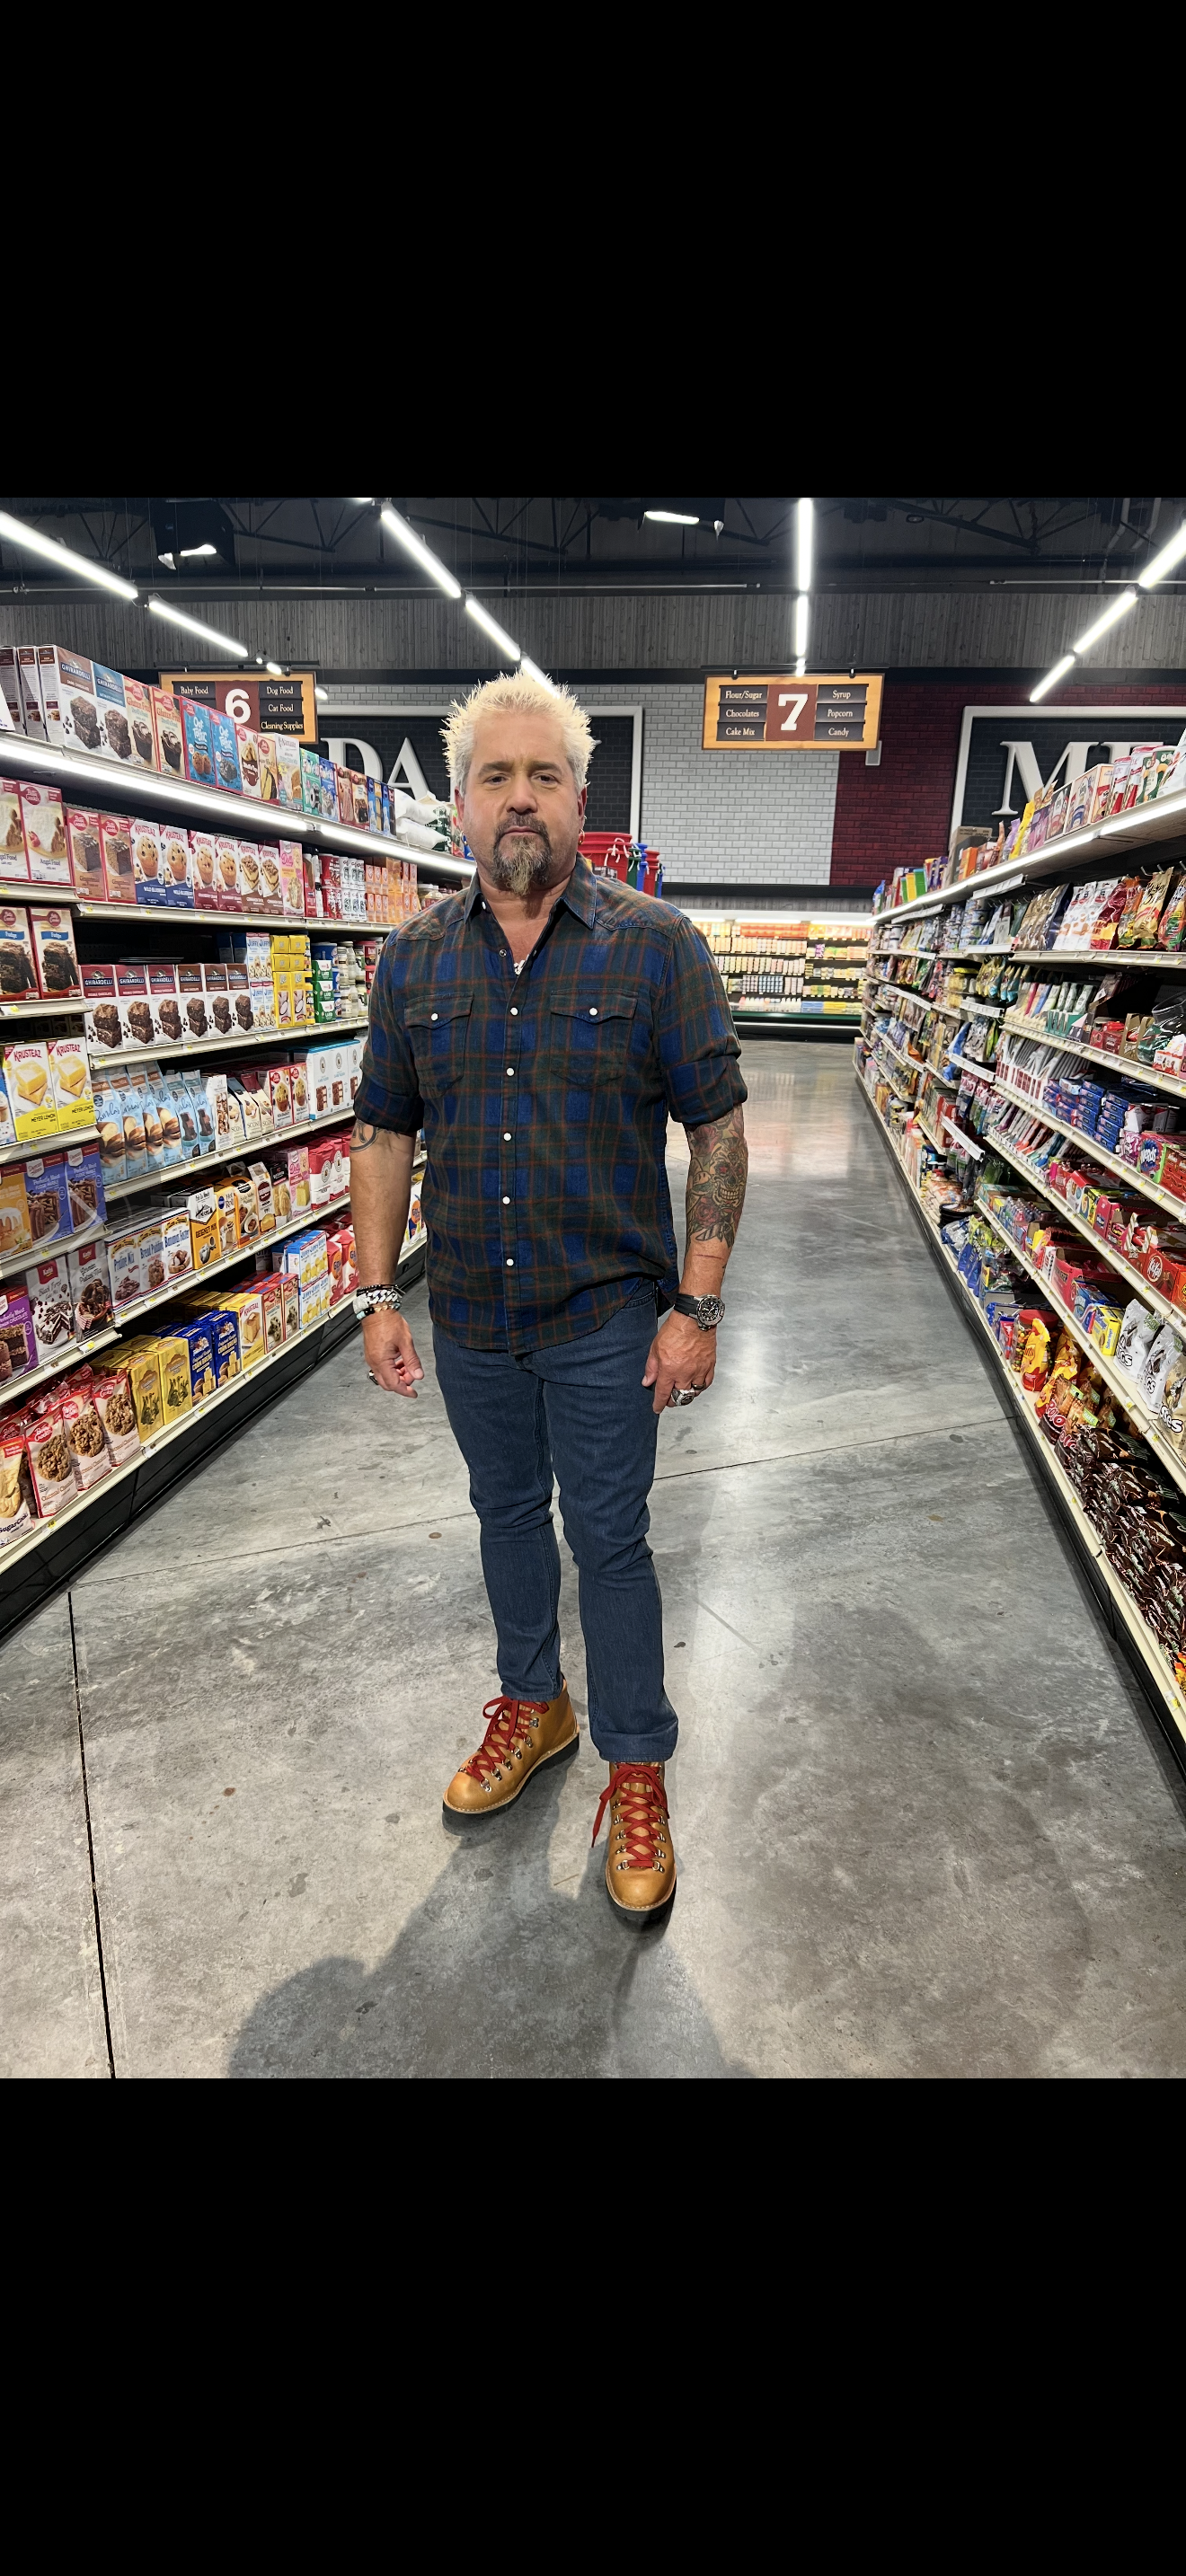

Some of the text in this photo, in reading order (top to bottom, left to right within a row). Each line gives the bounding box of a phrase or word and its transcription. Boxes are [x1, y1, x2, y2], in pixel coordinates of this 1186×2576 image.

[180, 685, 208, 695] Baby Food
[266, 686, 294, 695] Dog Food
[832, 690, 851, 700] Syrup
[725, 690, 762, 701] Flour/Sugar
[225, 688, 252, 724] 6
[268, 703, 294, 712] Cat Food
[725, 709, 759, 718] Chocolates
[777, 693, 809, 731] 7
[828, 709, 853, 718] Popcorn
[261, 721, 304, 731] Cleaning Supplies
[725, 728, 756, 736] Cake Mix
[828, 728, 849, 737] Candy
[84, 978, 113, 986] GHIRARDELLI
[56, 1044, 82, 1056] KRUSTEAZ
[13, 1049, 42, 1062] KRUSTEAZ
[1140, 1146, 1157, 1164] NERDS
